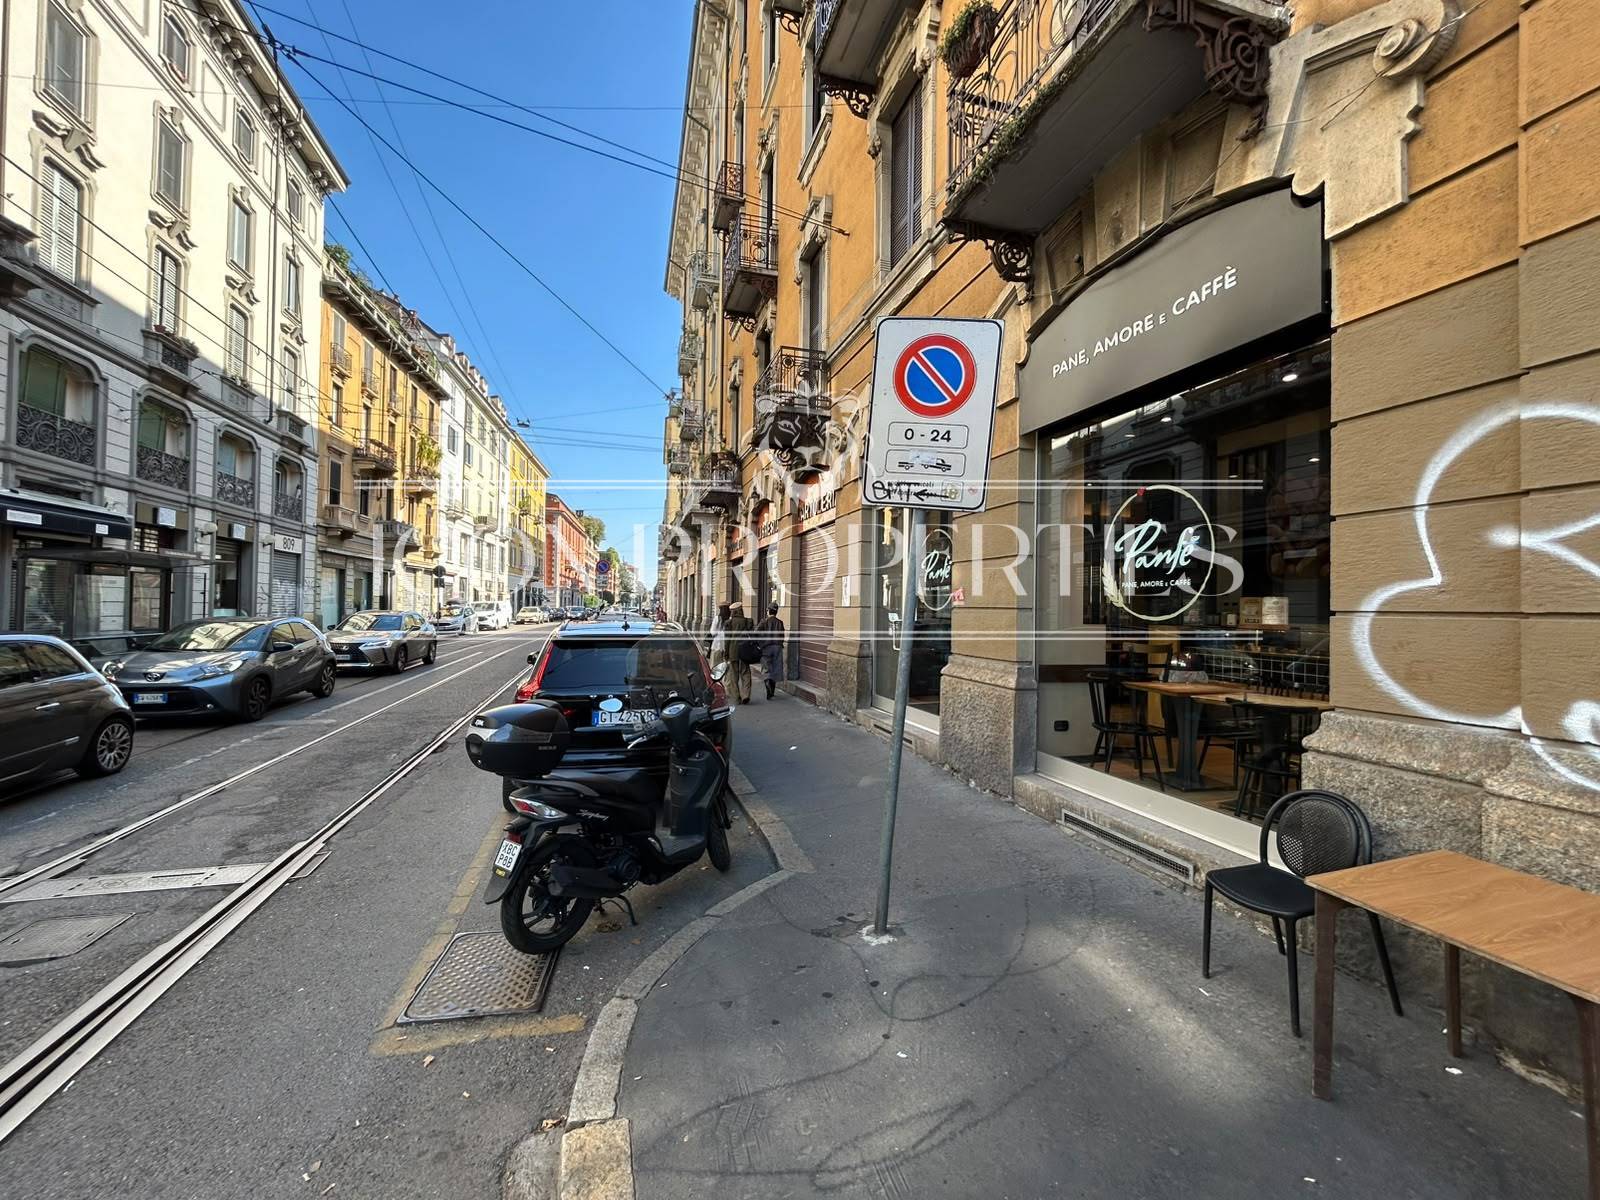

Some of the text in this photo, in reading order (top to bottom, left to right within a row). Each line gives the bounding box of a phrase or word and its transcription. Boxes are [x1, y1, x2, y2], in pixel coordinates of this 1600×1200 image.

[1051, 265, 1238, 378] PANE, AMORE E CAFFÈ
[930, 429, 952, 443] 24
